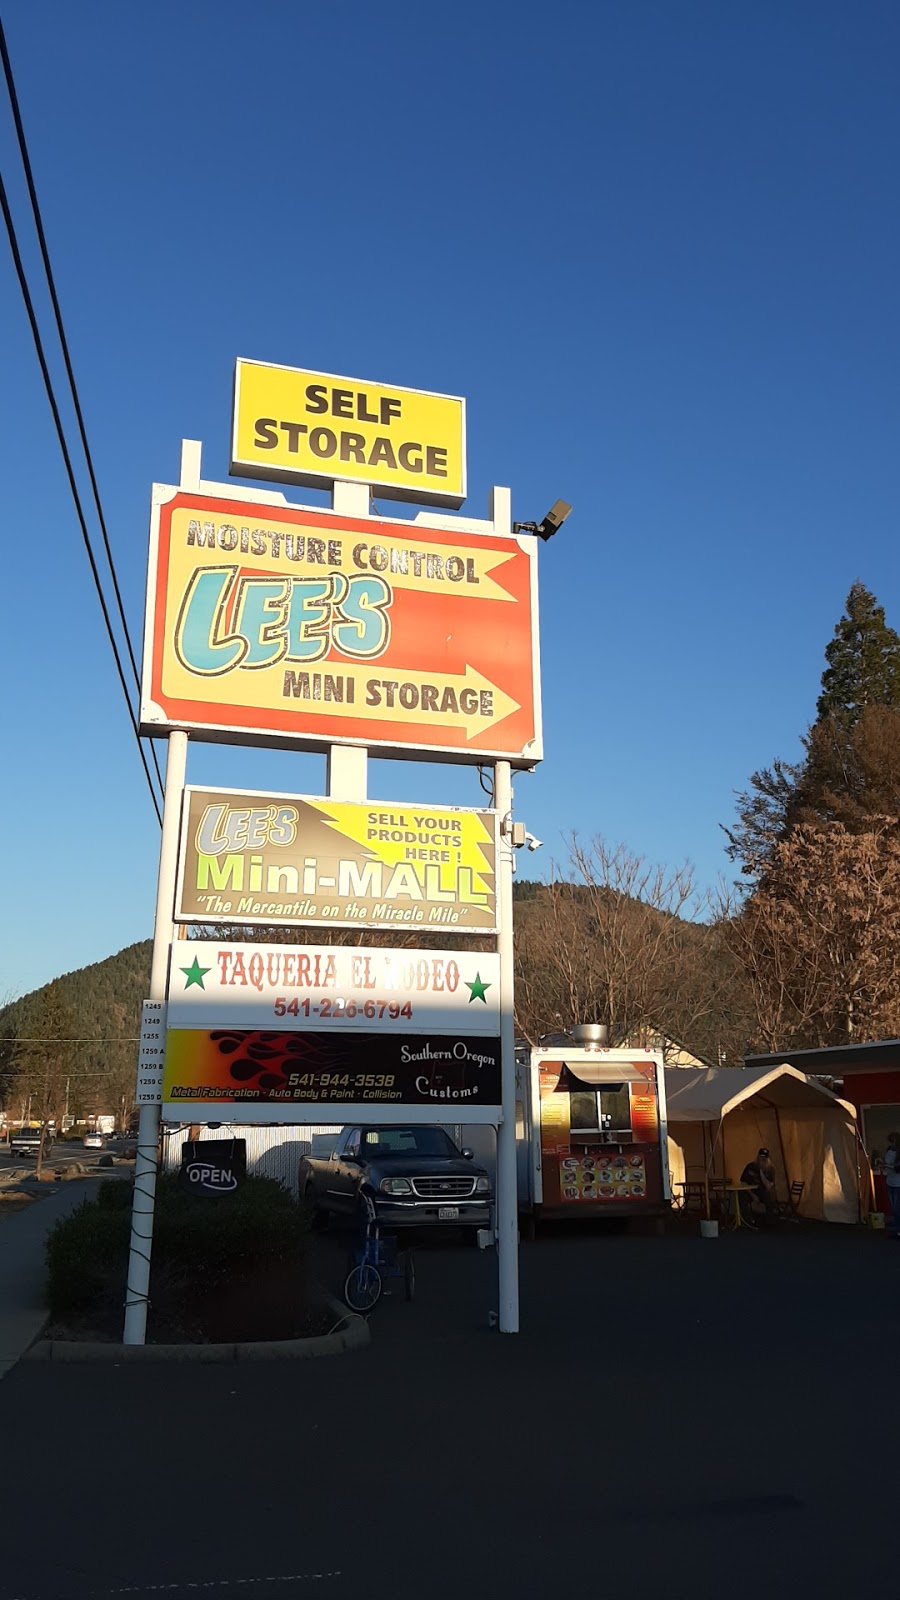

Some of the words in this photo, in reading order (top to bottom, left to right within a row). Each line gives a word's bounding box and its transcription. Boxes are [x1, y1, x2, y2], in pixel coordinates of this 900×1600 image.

[305, 384, 401, 426] SELF
[253, 418, 448, 478] STORAGE
[187, 519, 342, 566] MOISTURE
[352, 542, 480, 585] CONTROL
[174, 564, 393, 677] LEE'S
[282, 670, 355, 704] MINI
[365, 679, 494, 717] STORAGE
[195, 802, 299, 857] LEE'S
[367, 812, 409, 827] SELL
[413, 817, 462, 832] YOUR
[367, 829, 462, 847] PRODUCTS
[405, 847, 450, 862] HERE
[196, 853, 488, 904] Mini-MALL
[197, 895, 232, 913] "The
[237, 897, 317, 917] Mercantile
[321, 905, 340, 918] on
[344, 903, 367, 920] the
[372, 905, 424, 922] Miracle
[428, 907, 468, 924] Mile"
[217, 951, 338, 992] TAQUERIA
[351, 955, 377, 989] EL
[274, 997, 413, 1020] 541-226-6794
[401, 1042, 452, 1063] Southern
[453, 1041, 496, 1068] Oregon
[172, 1087, 201, 1097] Metal
[202, 1087, 260, 1098] Fabrication
[268, 1089, 291, 1098] Auto
[293, 1089, 319, 1100] Body
[320, 1089, 328, 1098] &
[330, 1089, 355, 1098] Paint
[363, 1089, 402, 1099] Collision
[288, 1073, 395, 1087] 541-944-3538
[415, 1075, 479, 1098] Customs
[189, 1169, 232, 1183] OPEN
